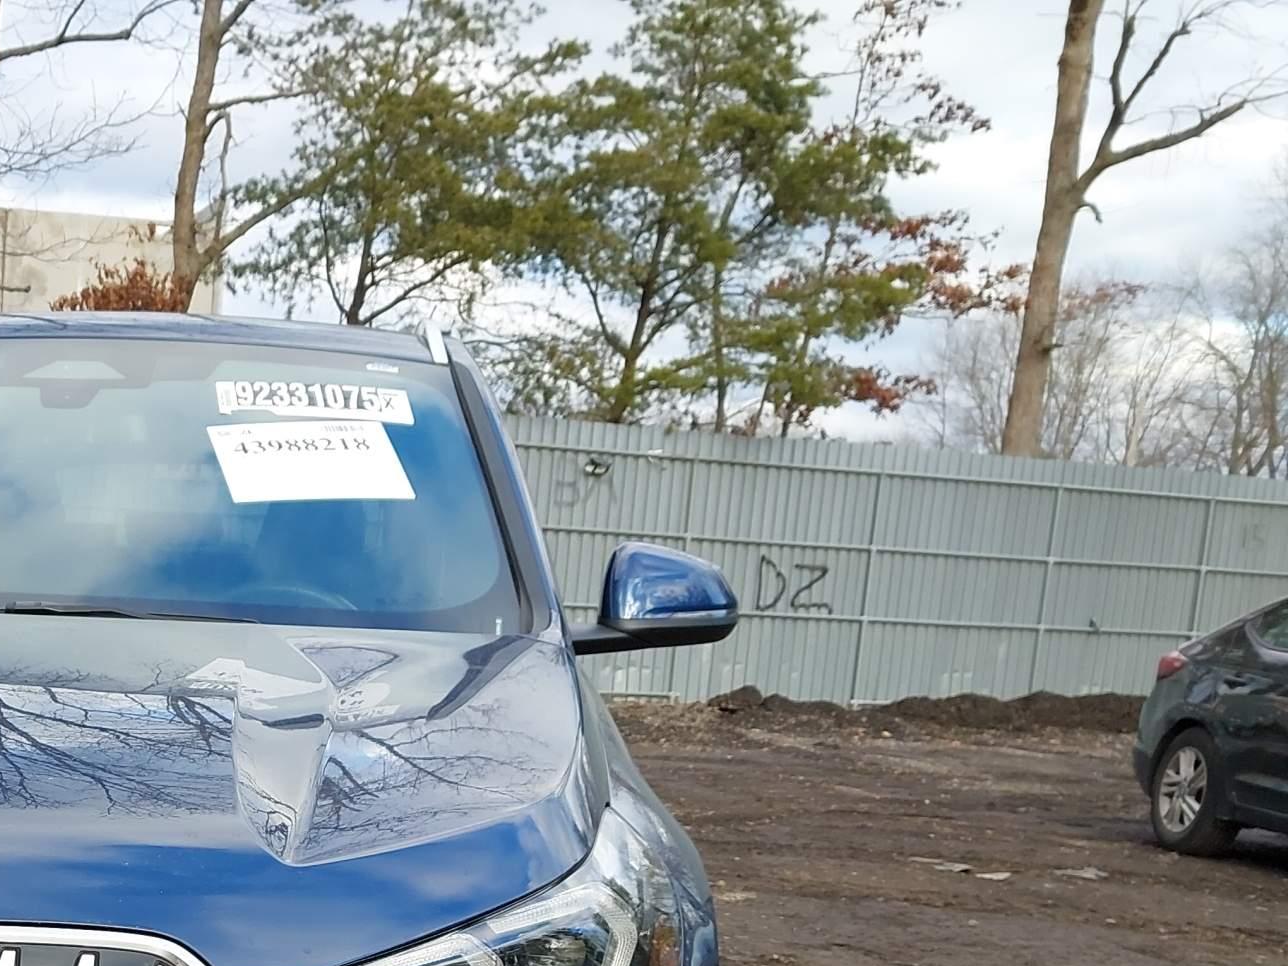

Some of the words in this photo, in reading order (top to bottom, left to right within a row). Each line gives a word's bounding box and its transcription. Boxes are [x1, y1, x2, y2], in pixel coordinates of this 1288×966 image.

[235, 381, 381, 412] 92331075
[233, 437, 371, 455] 43988218
[755, 553, 834, 615] DZ
